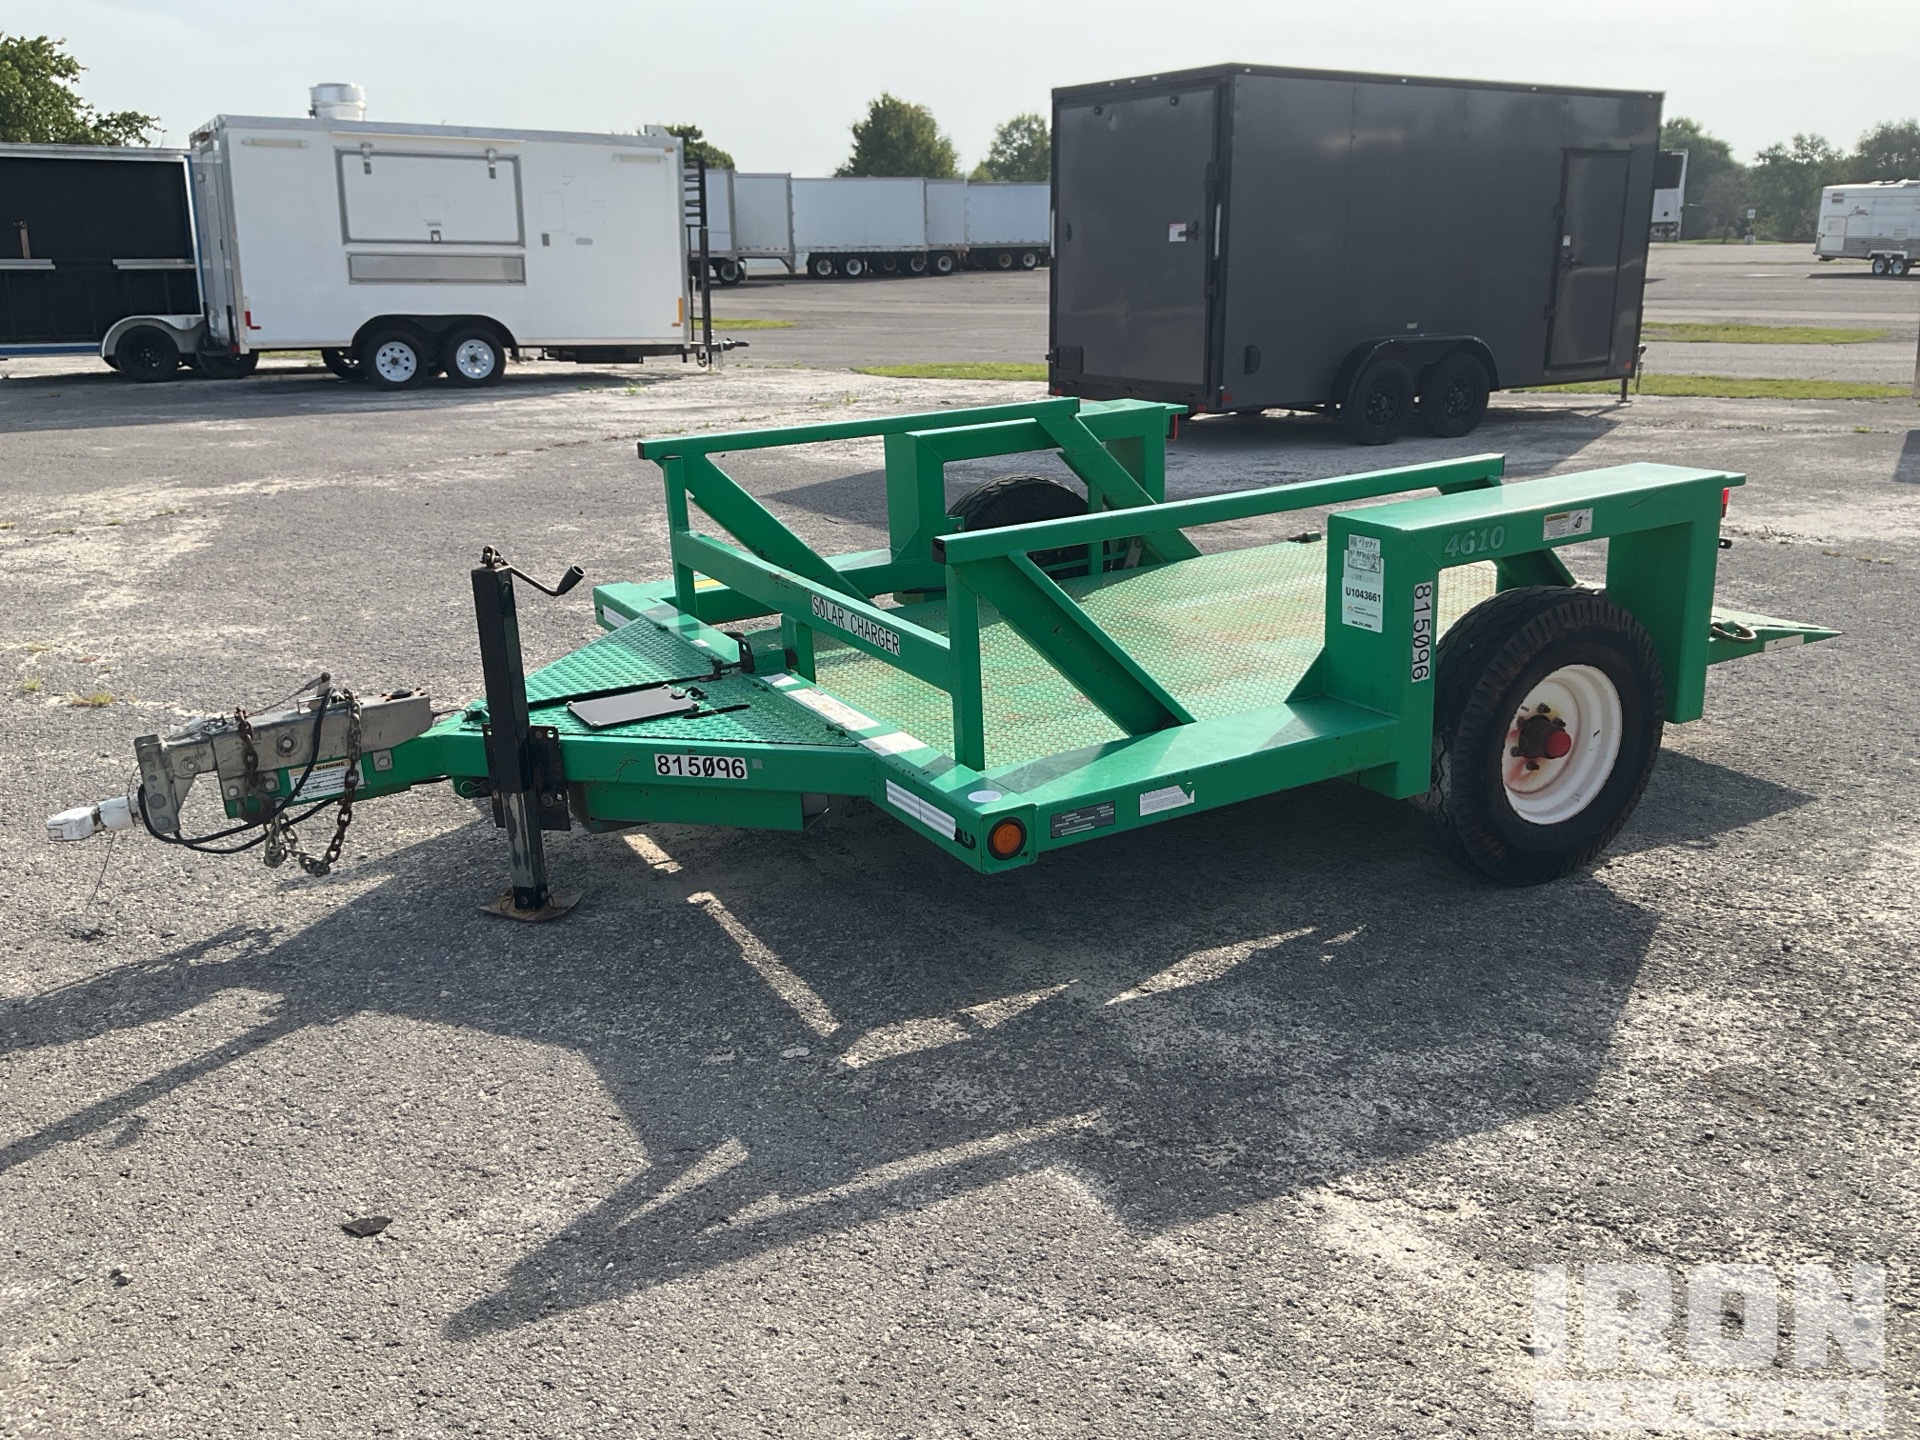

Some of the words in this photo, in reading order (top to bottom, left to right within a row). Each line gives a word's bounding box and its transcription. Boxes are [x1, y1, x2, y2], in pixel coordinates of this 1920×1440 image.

[1444, 525, 1505, 558] 4610
[1345, 586, 1381, 603] U1043661
[812, 596, 845, 629] SOLAR
[850, 614, 900, 656] CHARGER
[1412, 584, 1432, 680] 815096
[316, 761, 345, 771] WARNING
[657, 755, 745, 778] 815096
